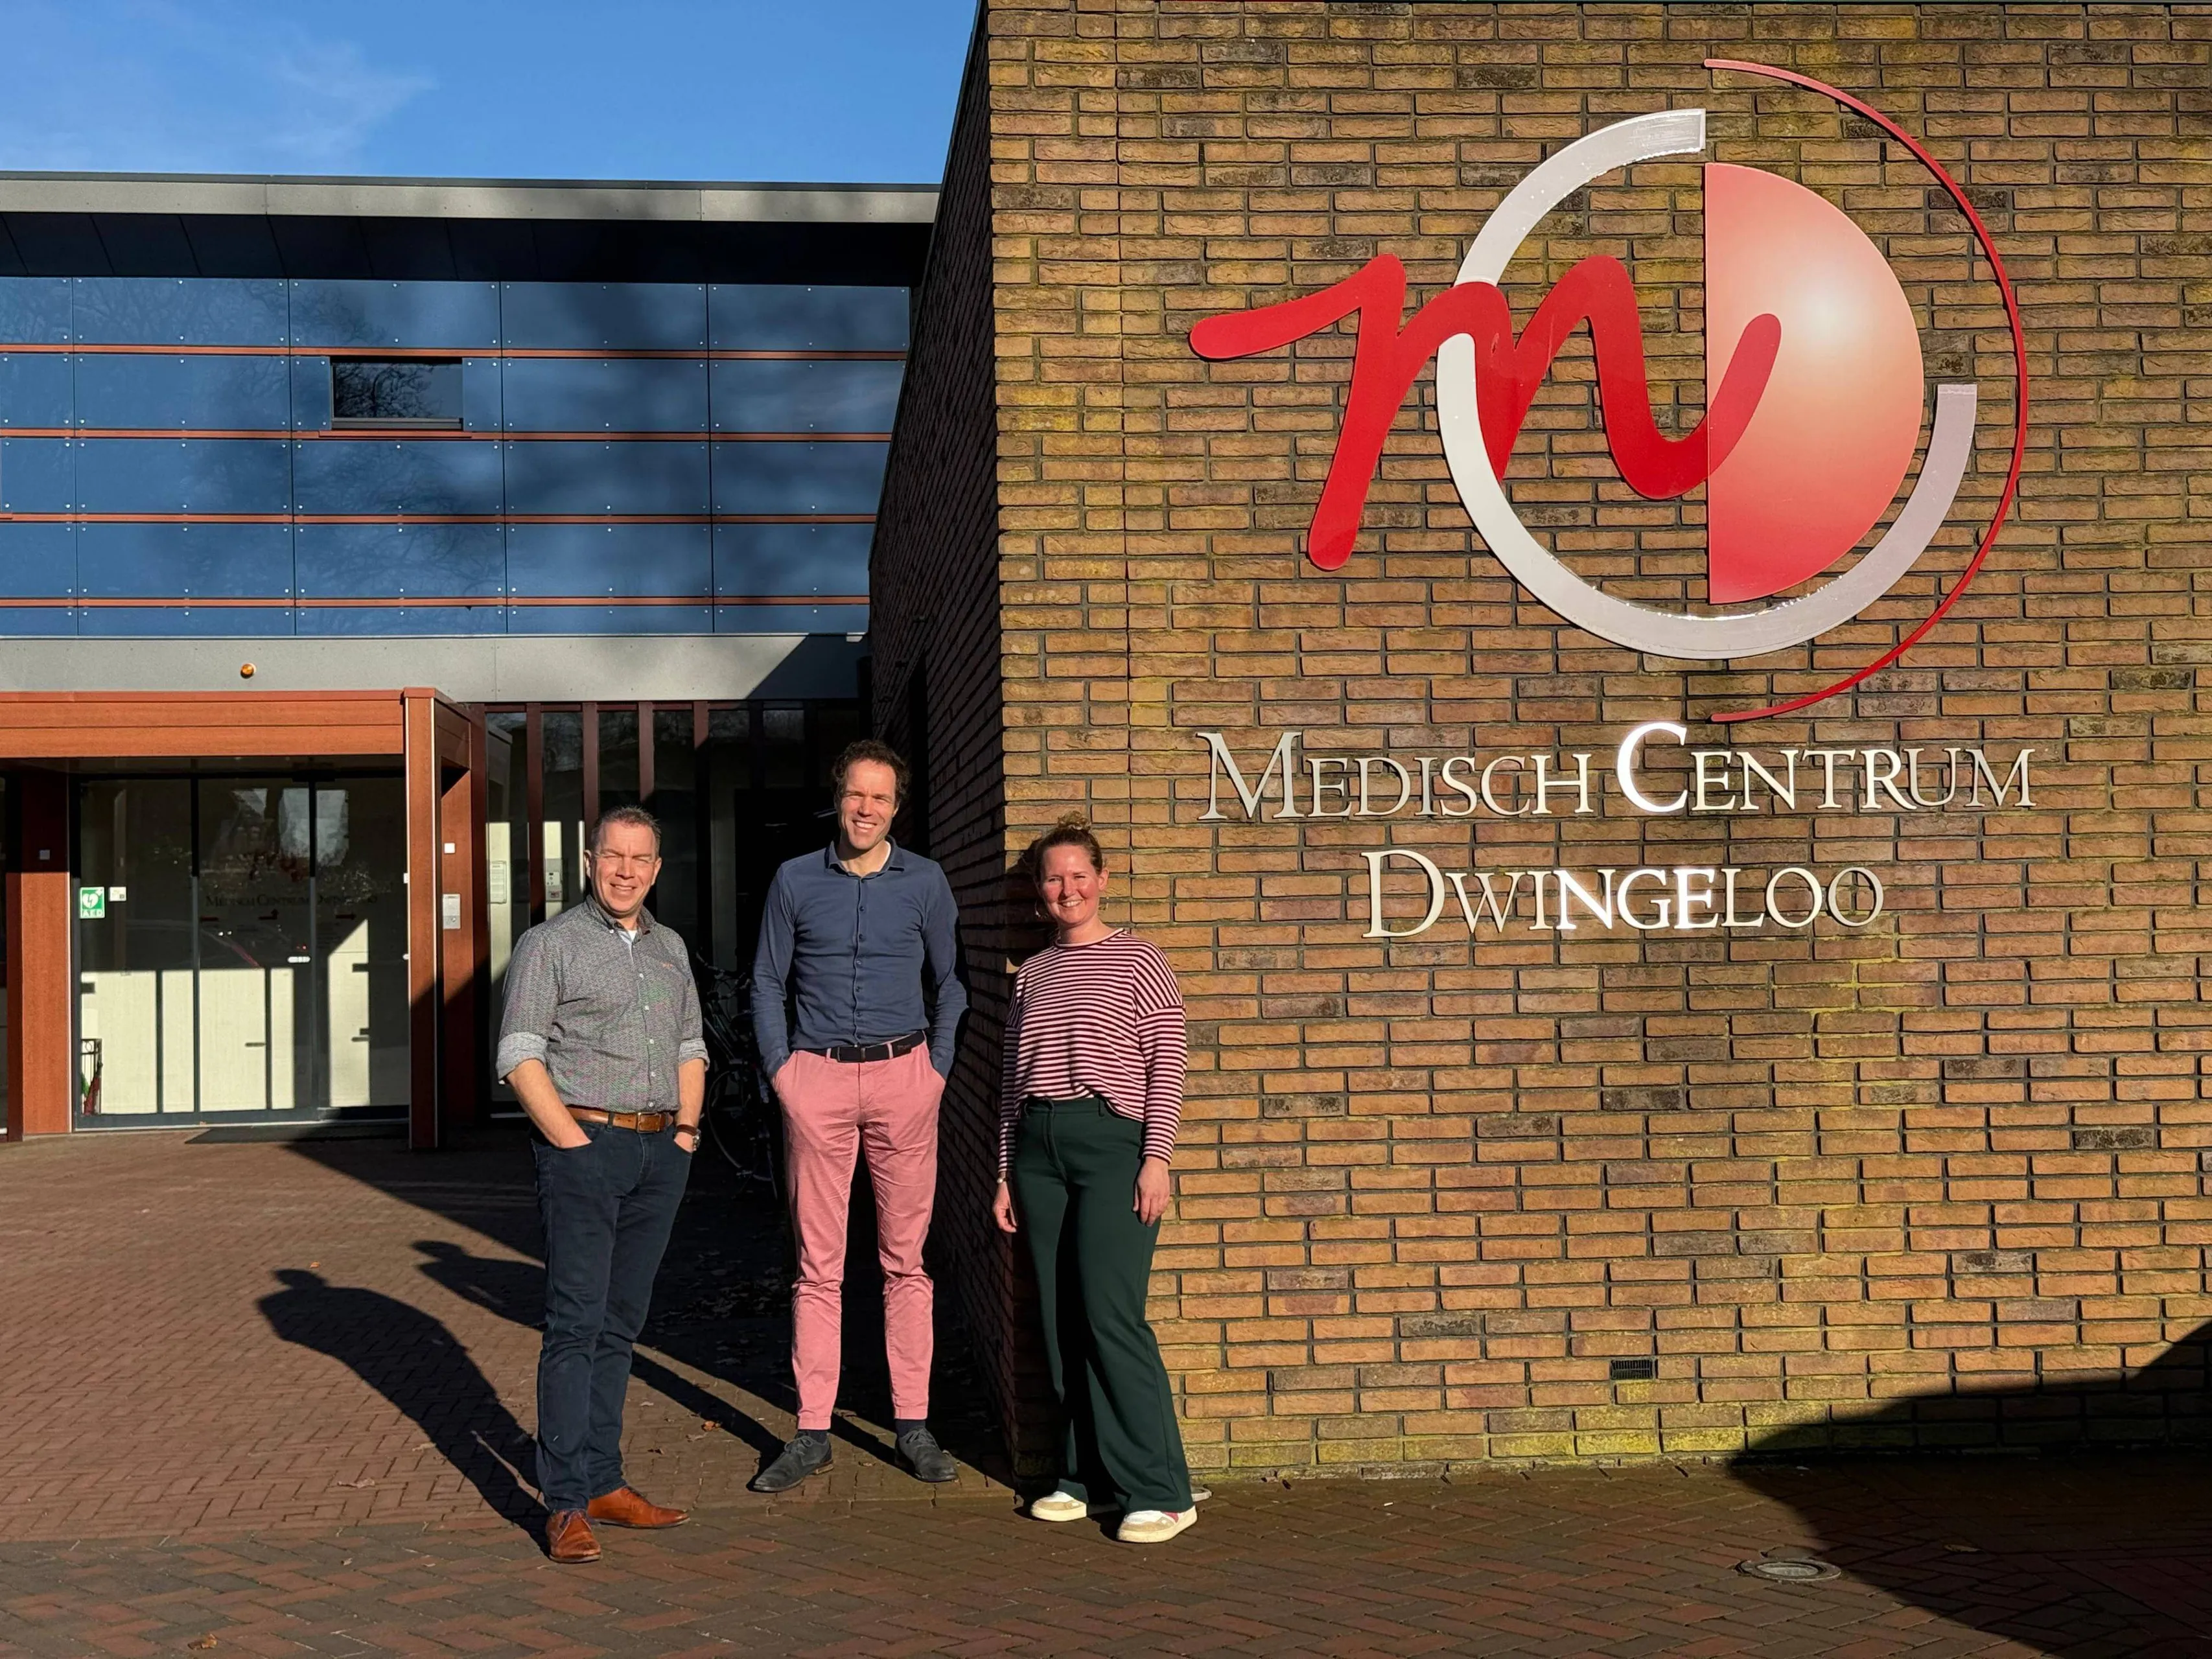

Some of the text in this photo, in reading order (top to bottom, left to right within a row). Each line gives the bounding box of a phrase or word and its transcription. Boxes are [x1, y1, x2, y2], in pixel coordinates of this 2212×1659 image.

[1196, 722, 2036, 820] MEDISCH CENTRUM
[1361, 849, 1885, 938] DWINGELOO
